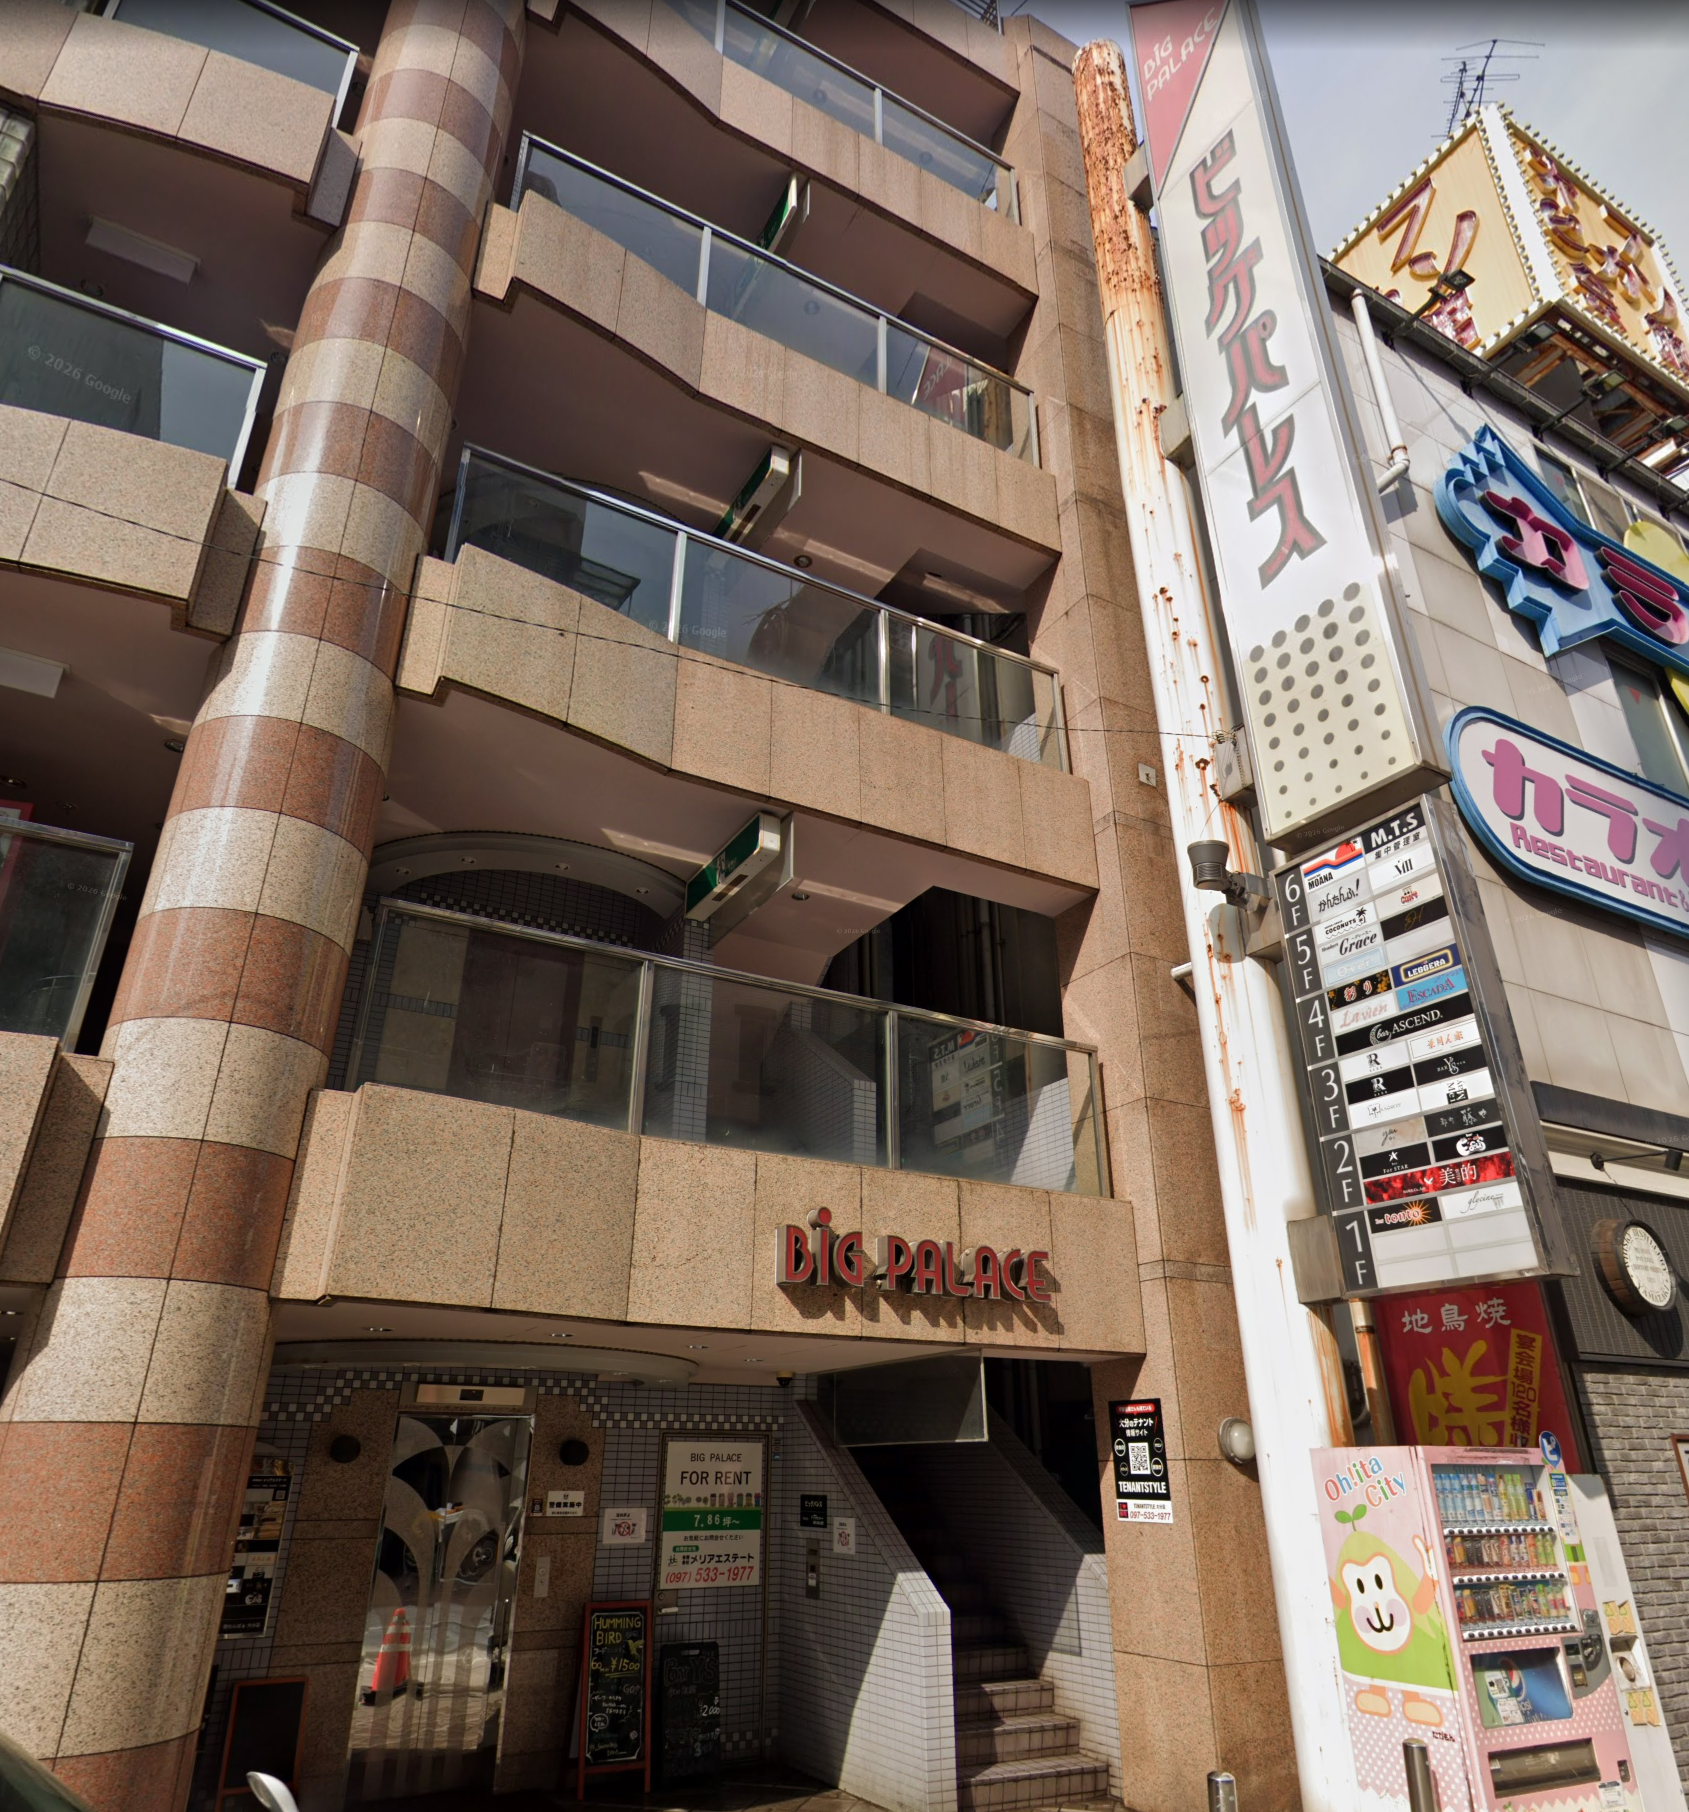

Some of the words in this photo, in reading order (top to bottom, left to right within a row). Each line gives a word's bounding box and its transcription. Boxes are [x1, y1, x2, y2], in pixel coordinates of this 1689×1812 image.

[1144, 34, 1173, 80] BIG
[1147, 7, 1218, 101] PALACE
[1189, 128, 1328, 590] ビッグパレス
[1371, 813, 1418, 848] M.T.S
[1510, 822, 1679, 909] Restaurant
[1308, 872, 1333, 890] MOANA
[1325, 918, 1357, 935] COCONUTS
[1340, 933, 1377, 956] Grace
[1407, 959, 1446, 977] LEGGERA
[1439, 1162, 1477, 1186] 美的
[775, 1207, 864, 1287] BIG
[875, 1235, 1052, 1303] PALACE
[1401, 1296, 1511, 1334] 地鳥焼
[690, 1453, 705, 1462] BIG
[710, 1453, 742, 1462] PALACE
[681, 1471, 709, 1485] FOR
[715, 1471, 752, 1485] RENT
[1118, 1481, 1167, 1493] TENANTSTYLE
[1365, 1472, 1406, 1508] City
[1130, 1511, 1171, 1520] 097-533-1977
[665, 1571, 692, 1584] (097)
[695, 1566, 755, 1583] 533-1977
[594, 1616, 642, 1630] HUMMING
[596, 1631, 622, 1646] BIRD
